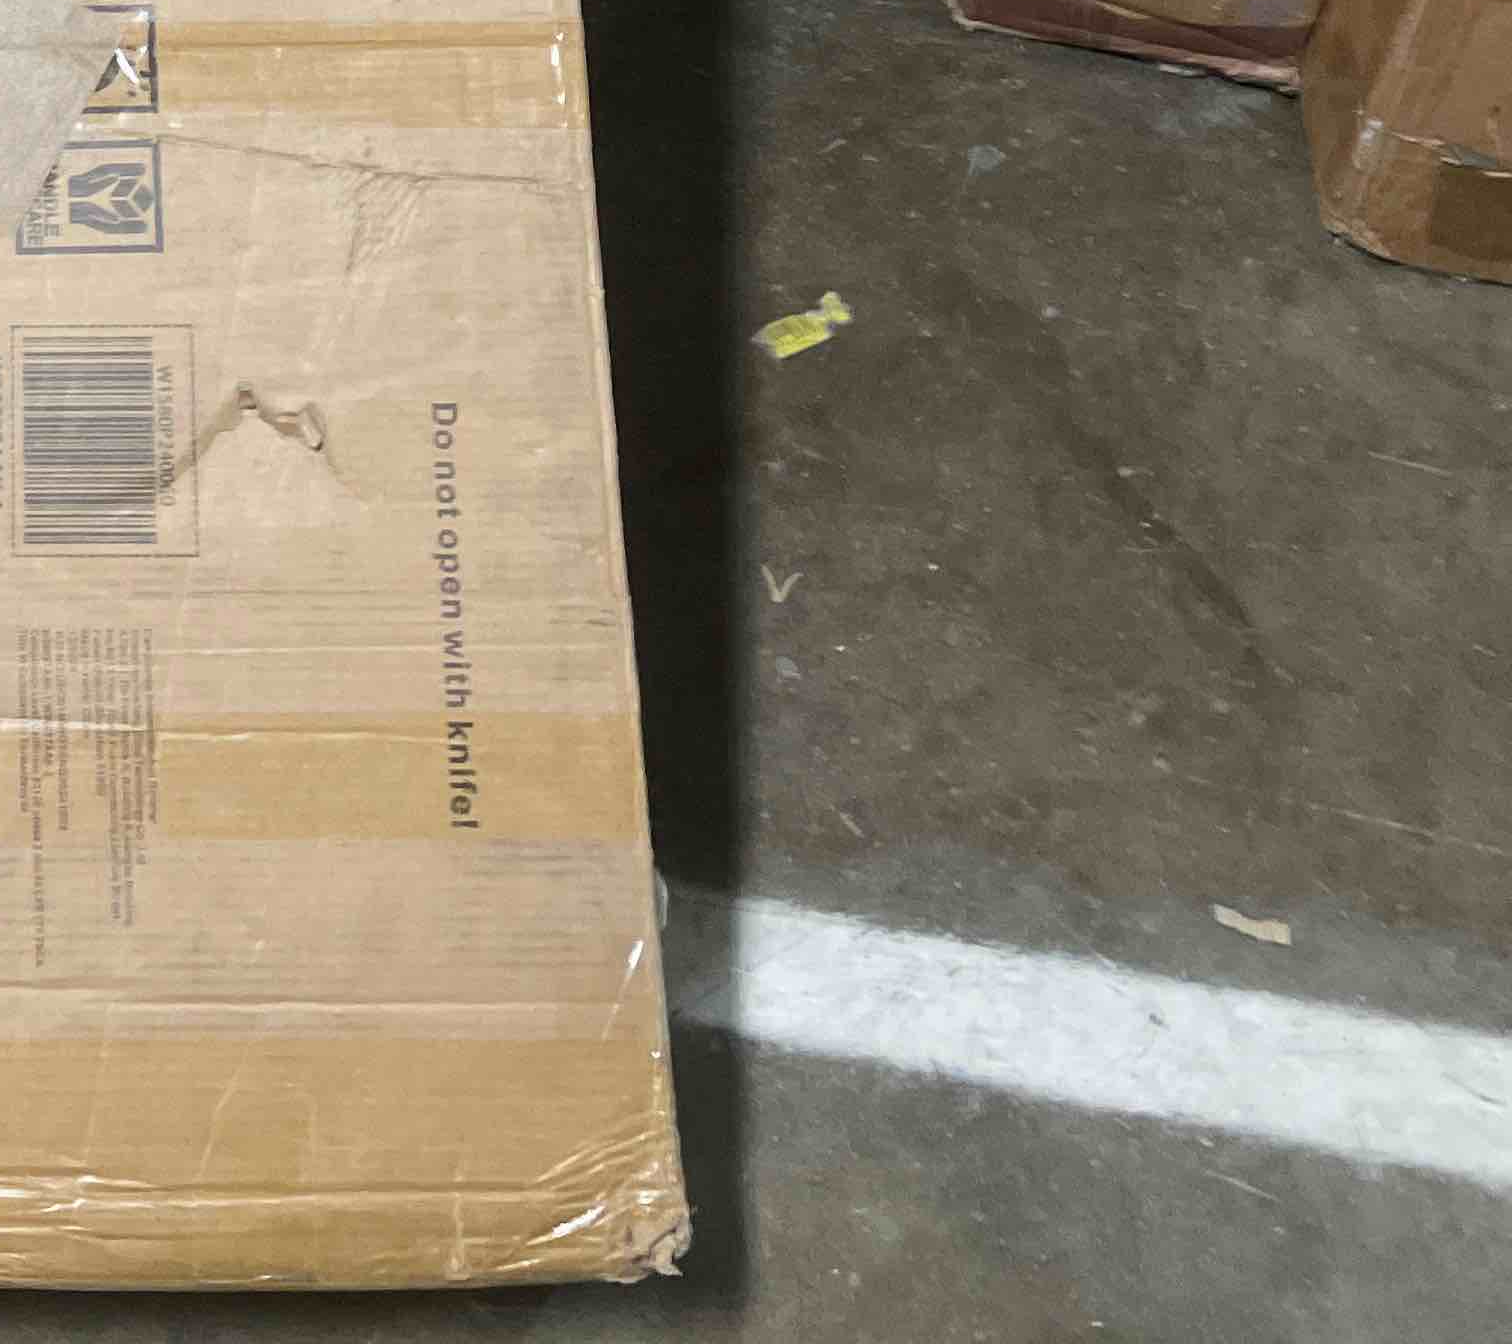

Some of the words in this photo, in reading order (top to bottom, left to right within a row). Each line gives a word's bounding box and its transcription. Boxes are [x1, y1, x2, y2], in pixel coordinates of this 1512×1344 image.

[42, 163, 62, 239] ANDLE
[432, 402, 459, 450] Do
[433, 460, 462, 520] not
[432, 528, 464, 619] open
[440, 630, 472, 709] with
[447, 721, 480, 829] knife!
